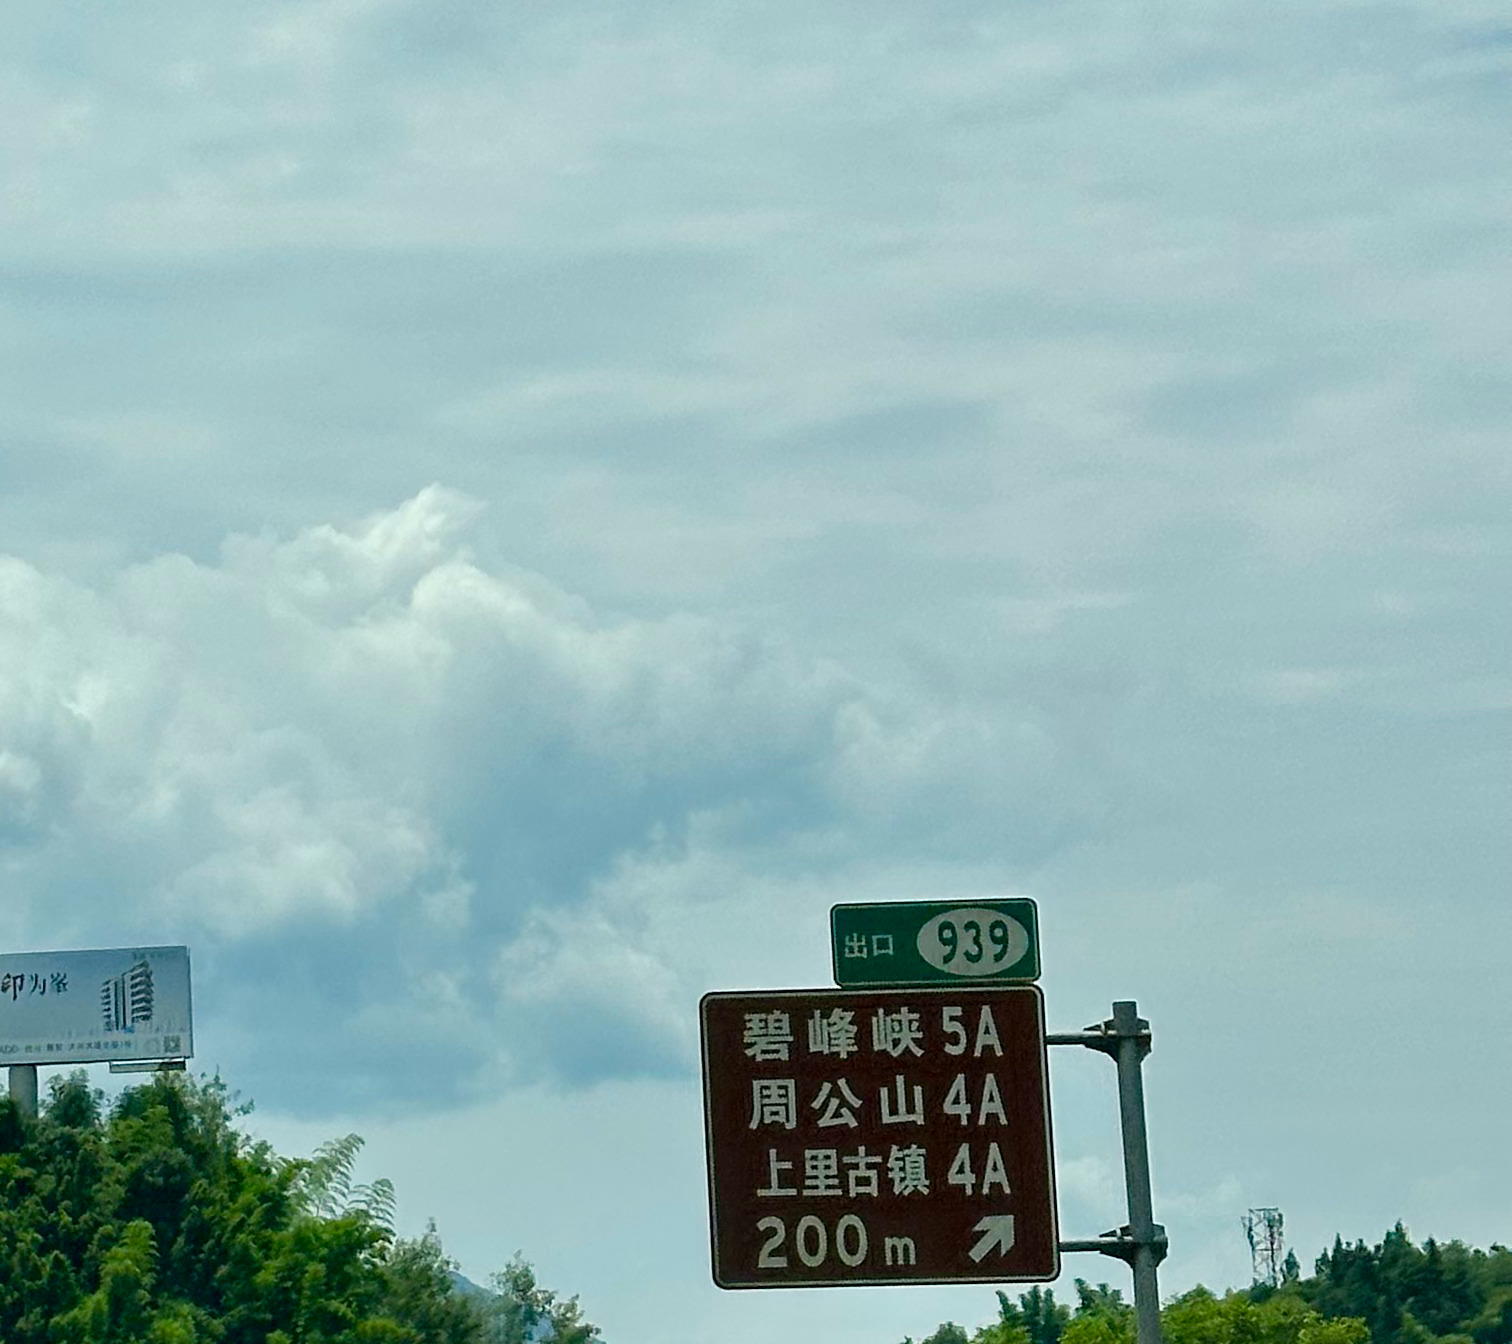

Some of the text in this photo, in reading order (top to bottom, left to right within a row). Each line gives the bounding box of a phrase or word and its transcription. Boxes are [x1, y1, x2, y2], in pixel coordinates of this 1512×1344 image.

[844, 919, 1009, 964] 出口 939
[743, 1004, 1004, 1062] 碧峰峡 5A
[748, 1072, 1009, 1131] 周公山 4A
[756, 1141, 1012, 1199] 上里古镇 4A
